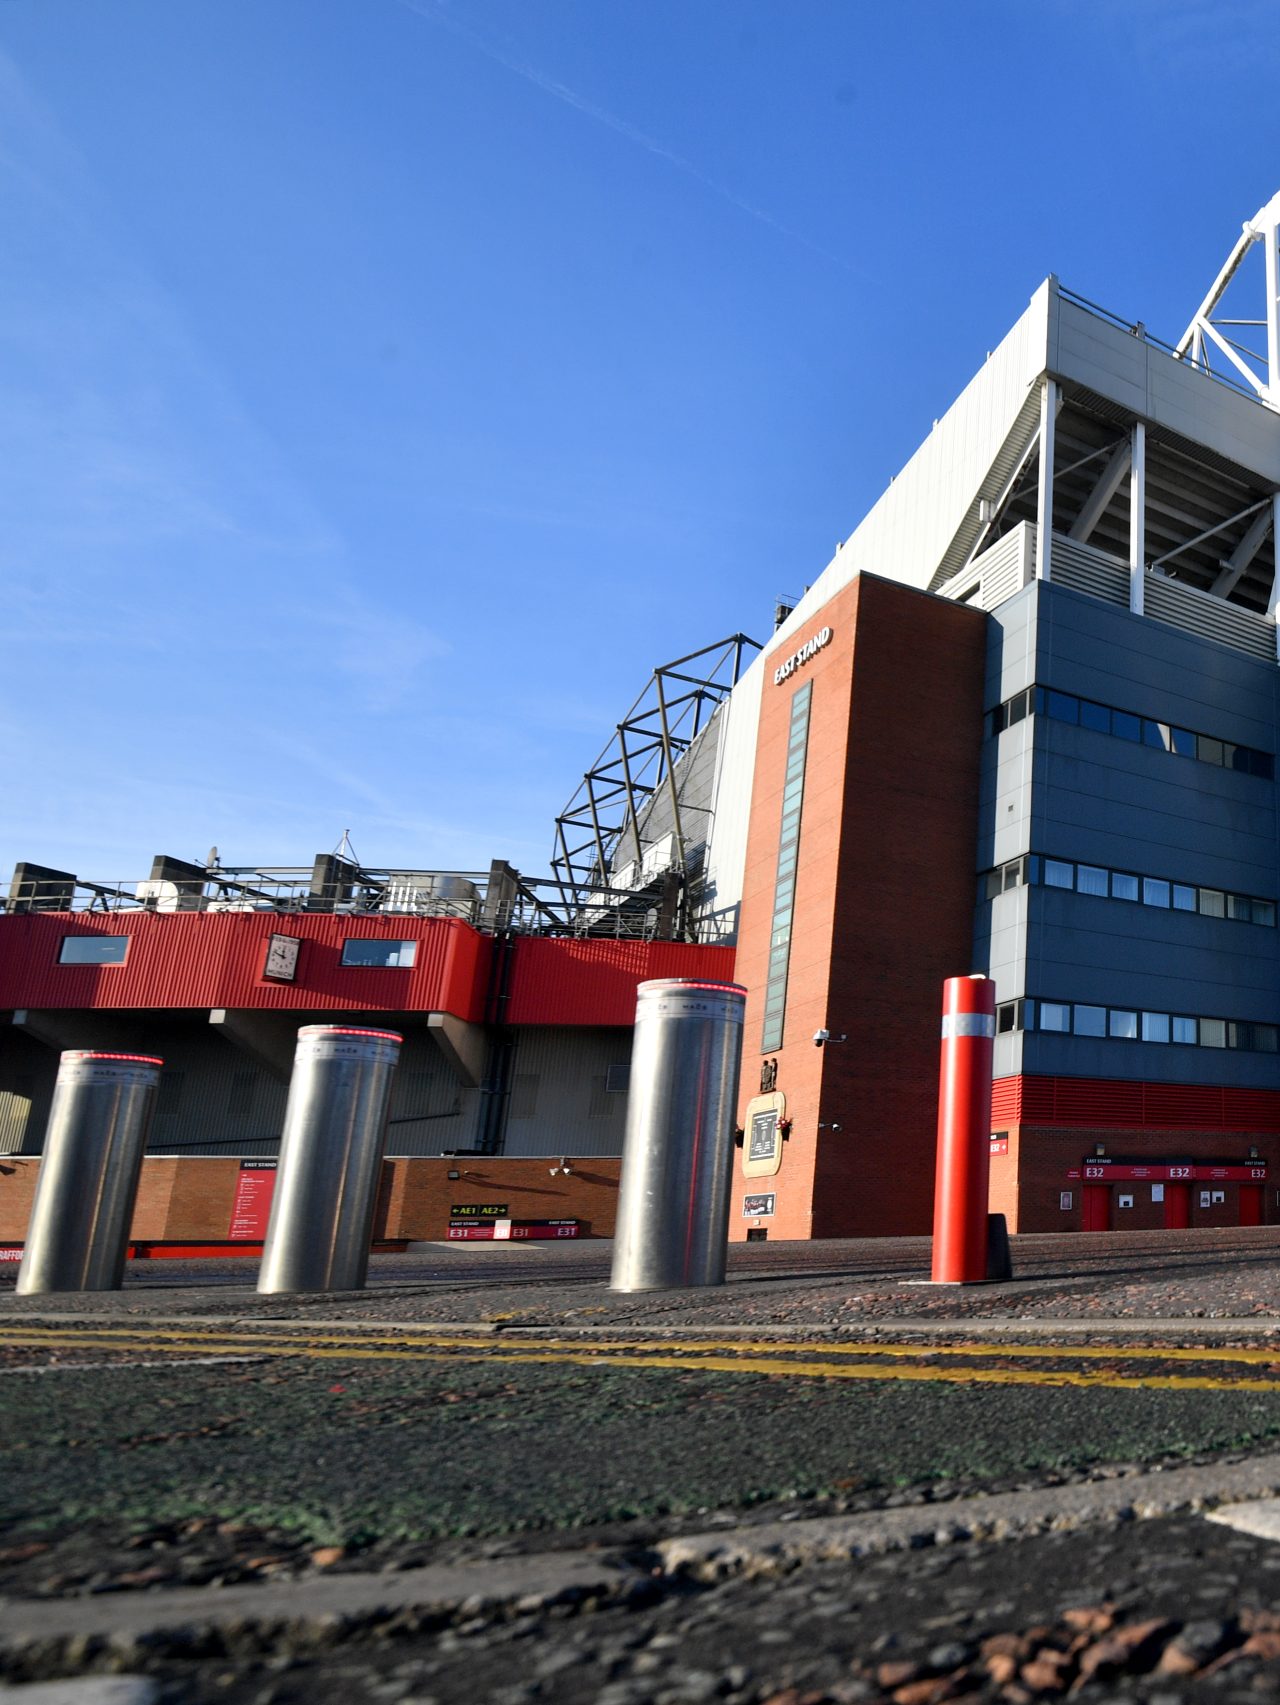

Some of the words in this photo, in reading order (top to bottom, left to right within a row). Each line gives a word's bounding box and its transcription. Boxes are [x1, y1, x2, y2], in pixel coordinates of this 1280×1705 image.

[774, 656, 798, 685] EAST
[797, 626, 832, 666] STAND
[1086, 1167, 1104, 1178] E32
[1169, 1167, 1190, 1178] E32
[1251, 1169, 1266, 1178] E32
[449, 1229, 469, 1237] E31
[512, 1228, 529, 1236] E31
[557, 1227, 576, 1236] E31
